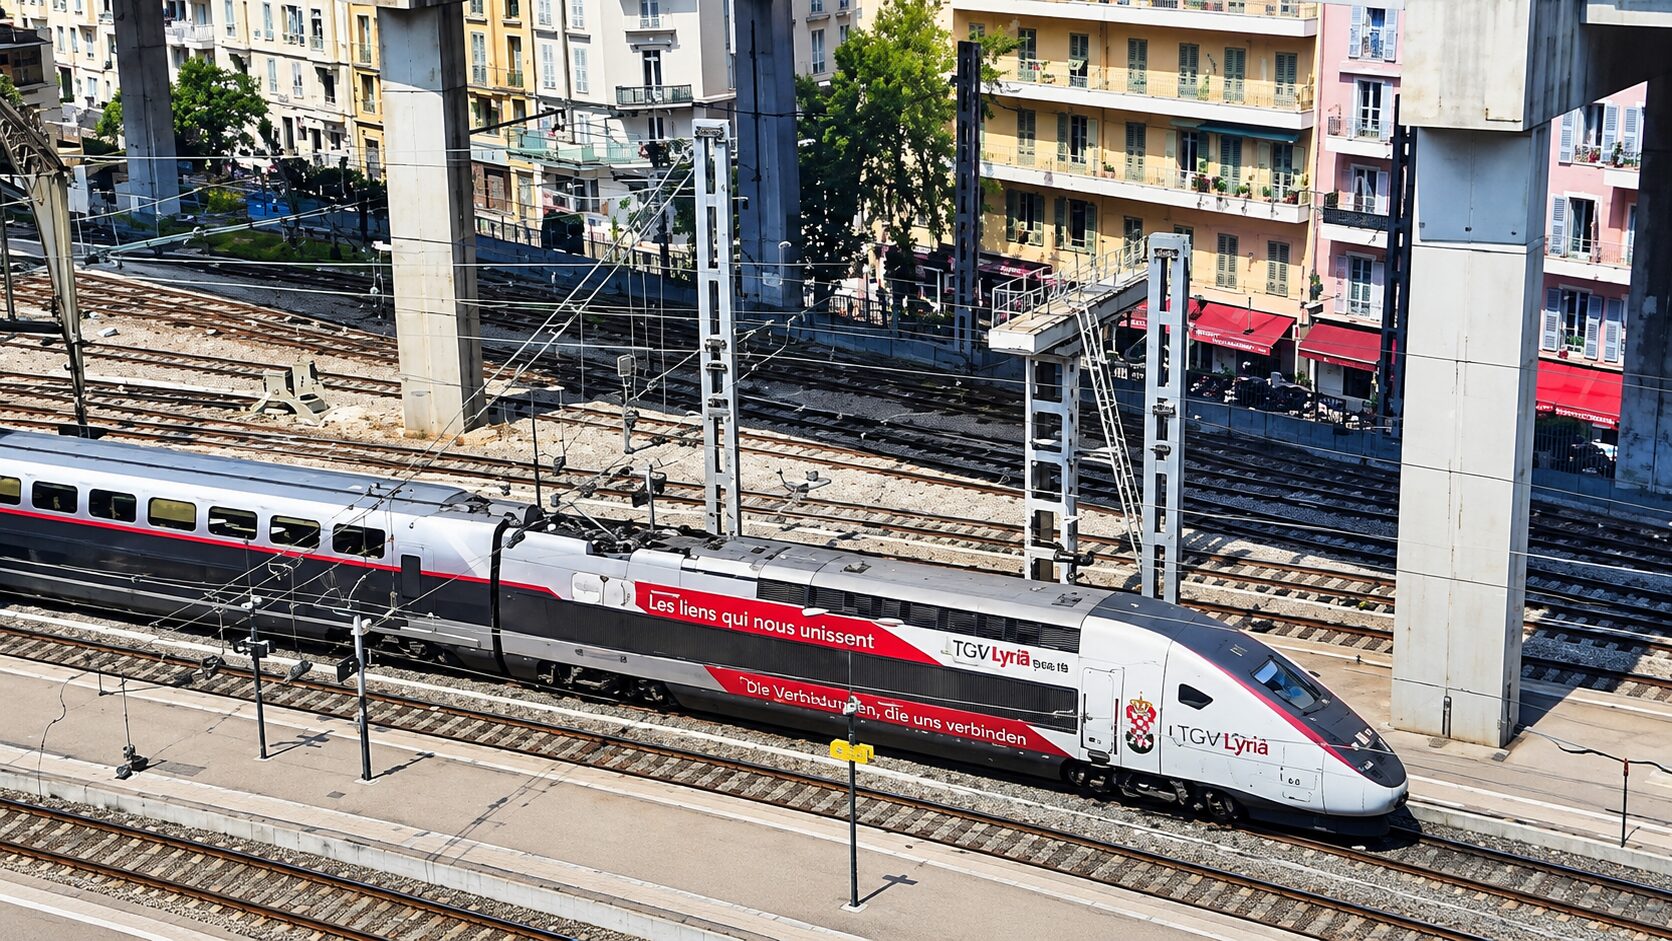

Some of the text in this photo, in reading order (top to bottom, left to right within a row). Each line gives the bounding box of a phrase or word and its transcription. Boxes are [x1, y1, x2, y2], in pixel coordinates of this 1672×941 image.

[649, 593, 875, 649] Les liens qui nous unissent
[953, 639, 990, 660] TGV
[746, 681, 770, 696] Die
[884, 706, 910, 723] die
[913, 715, 942, 730] uns
[946, 721, 1027, 746] verbinden
[1177, 724, 1221, 747] TGV
